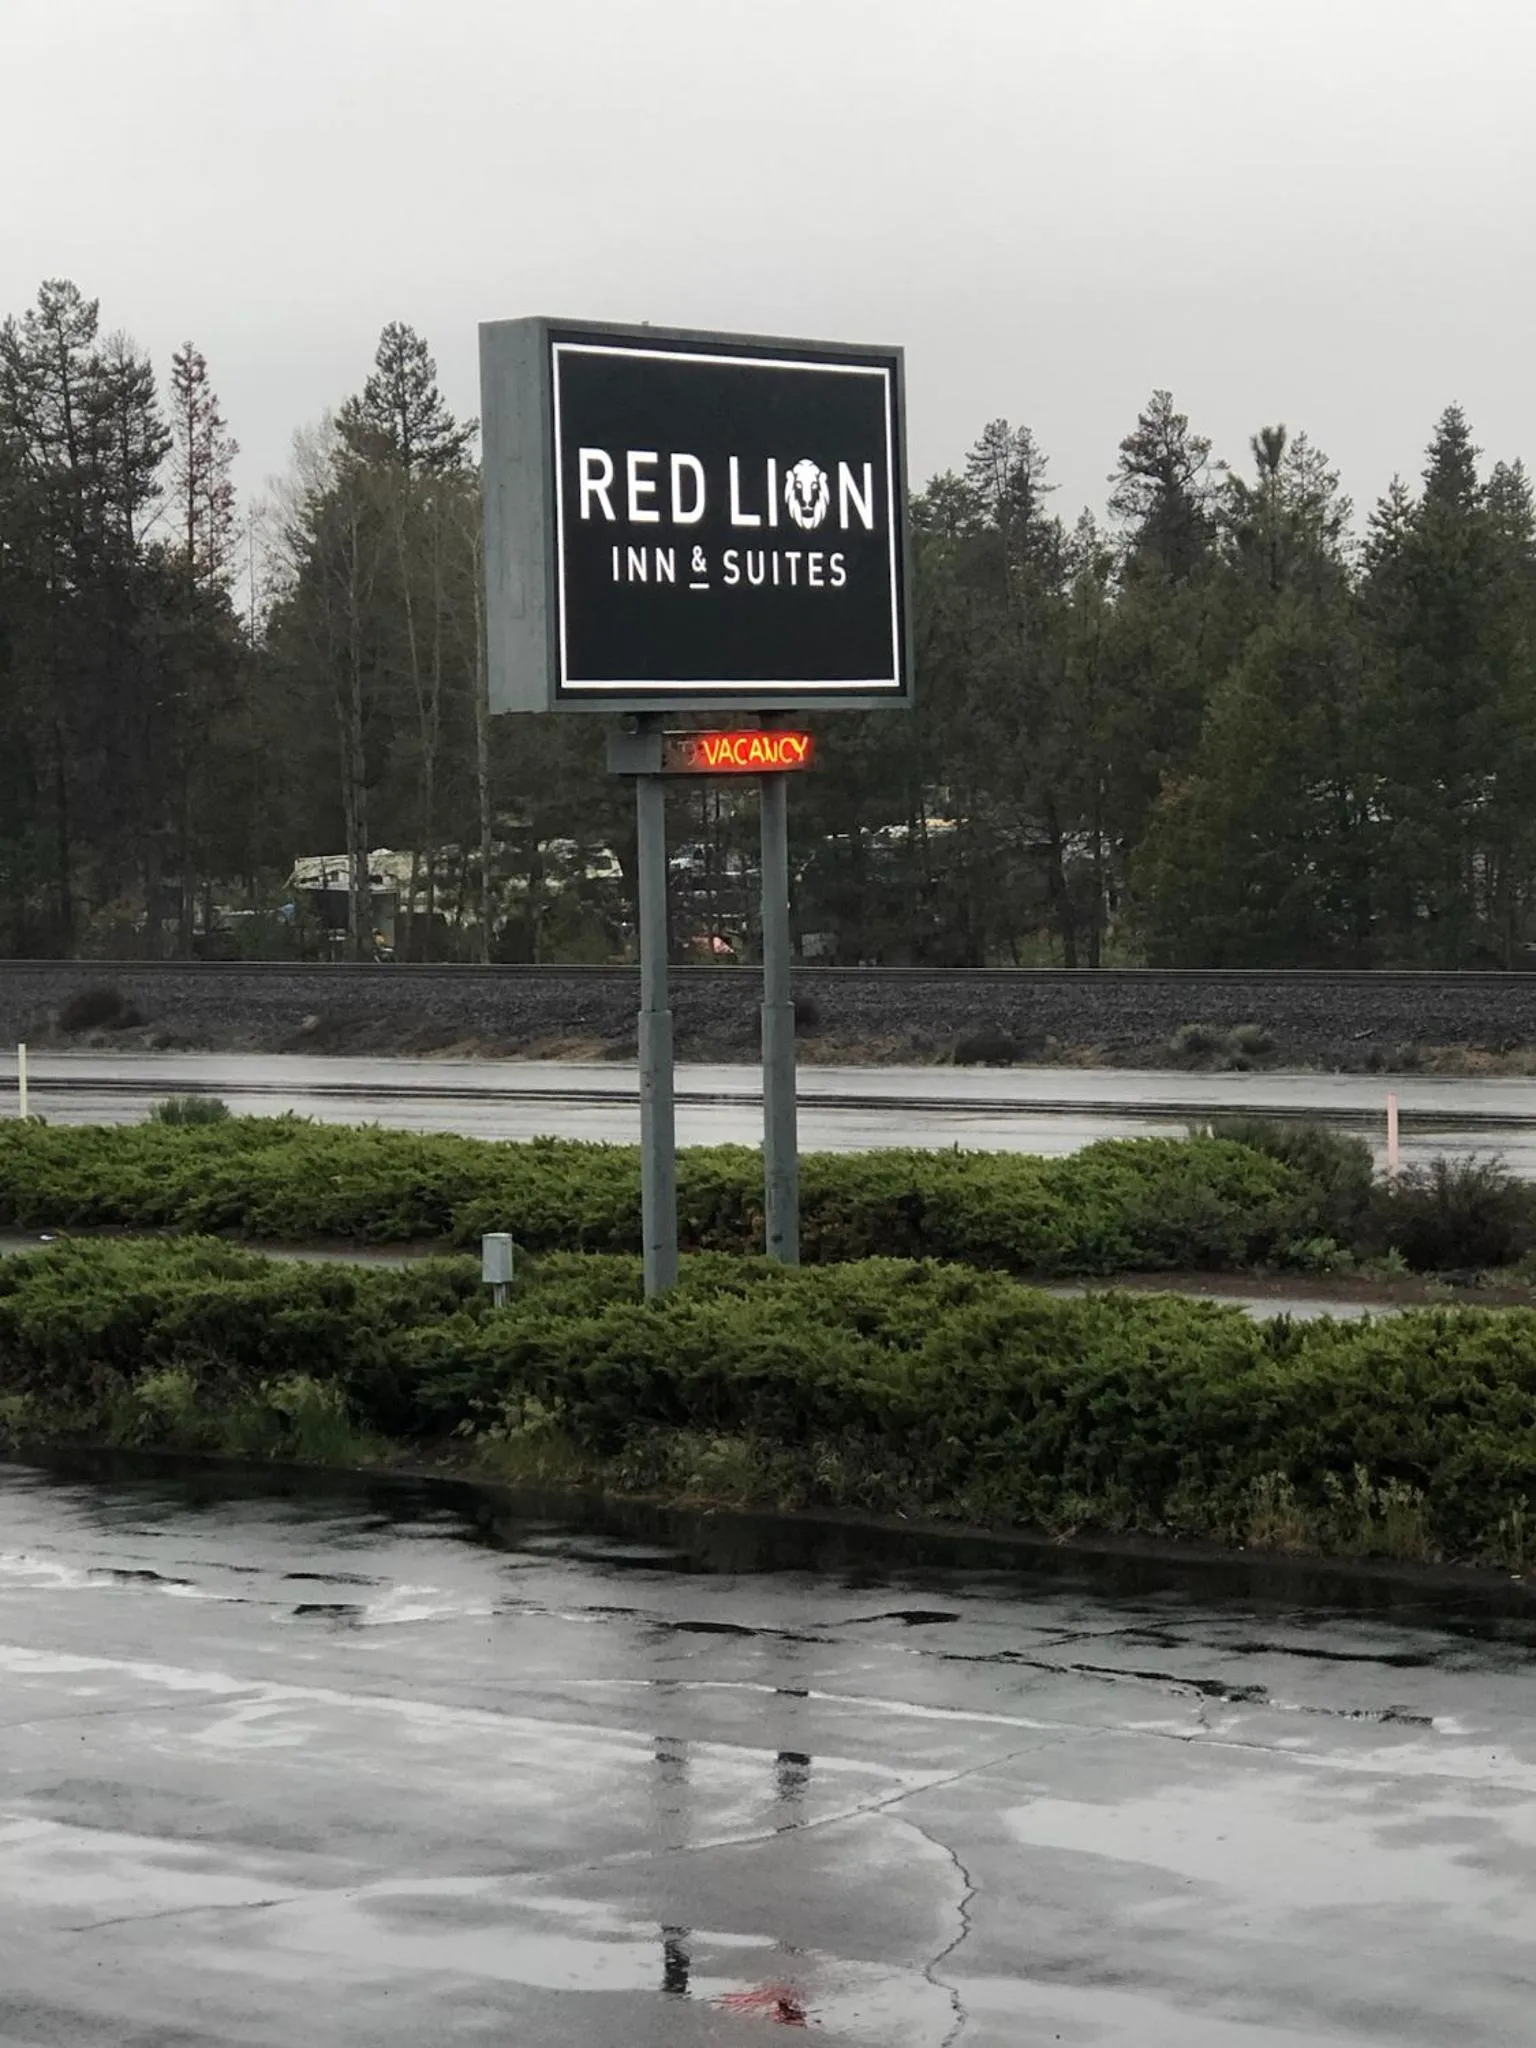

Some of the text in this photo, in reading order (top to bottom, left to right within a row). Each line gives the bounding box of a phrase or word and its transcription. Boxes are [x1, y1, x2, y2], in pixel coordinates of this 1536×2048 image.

[578, 447, 874, 530] RED LION
[611, 545, 847, 587] INN & SUITES
[702, 735, 809, 766] VACANCY
